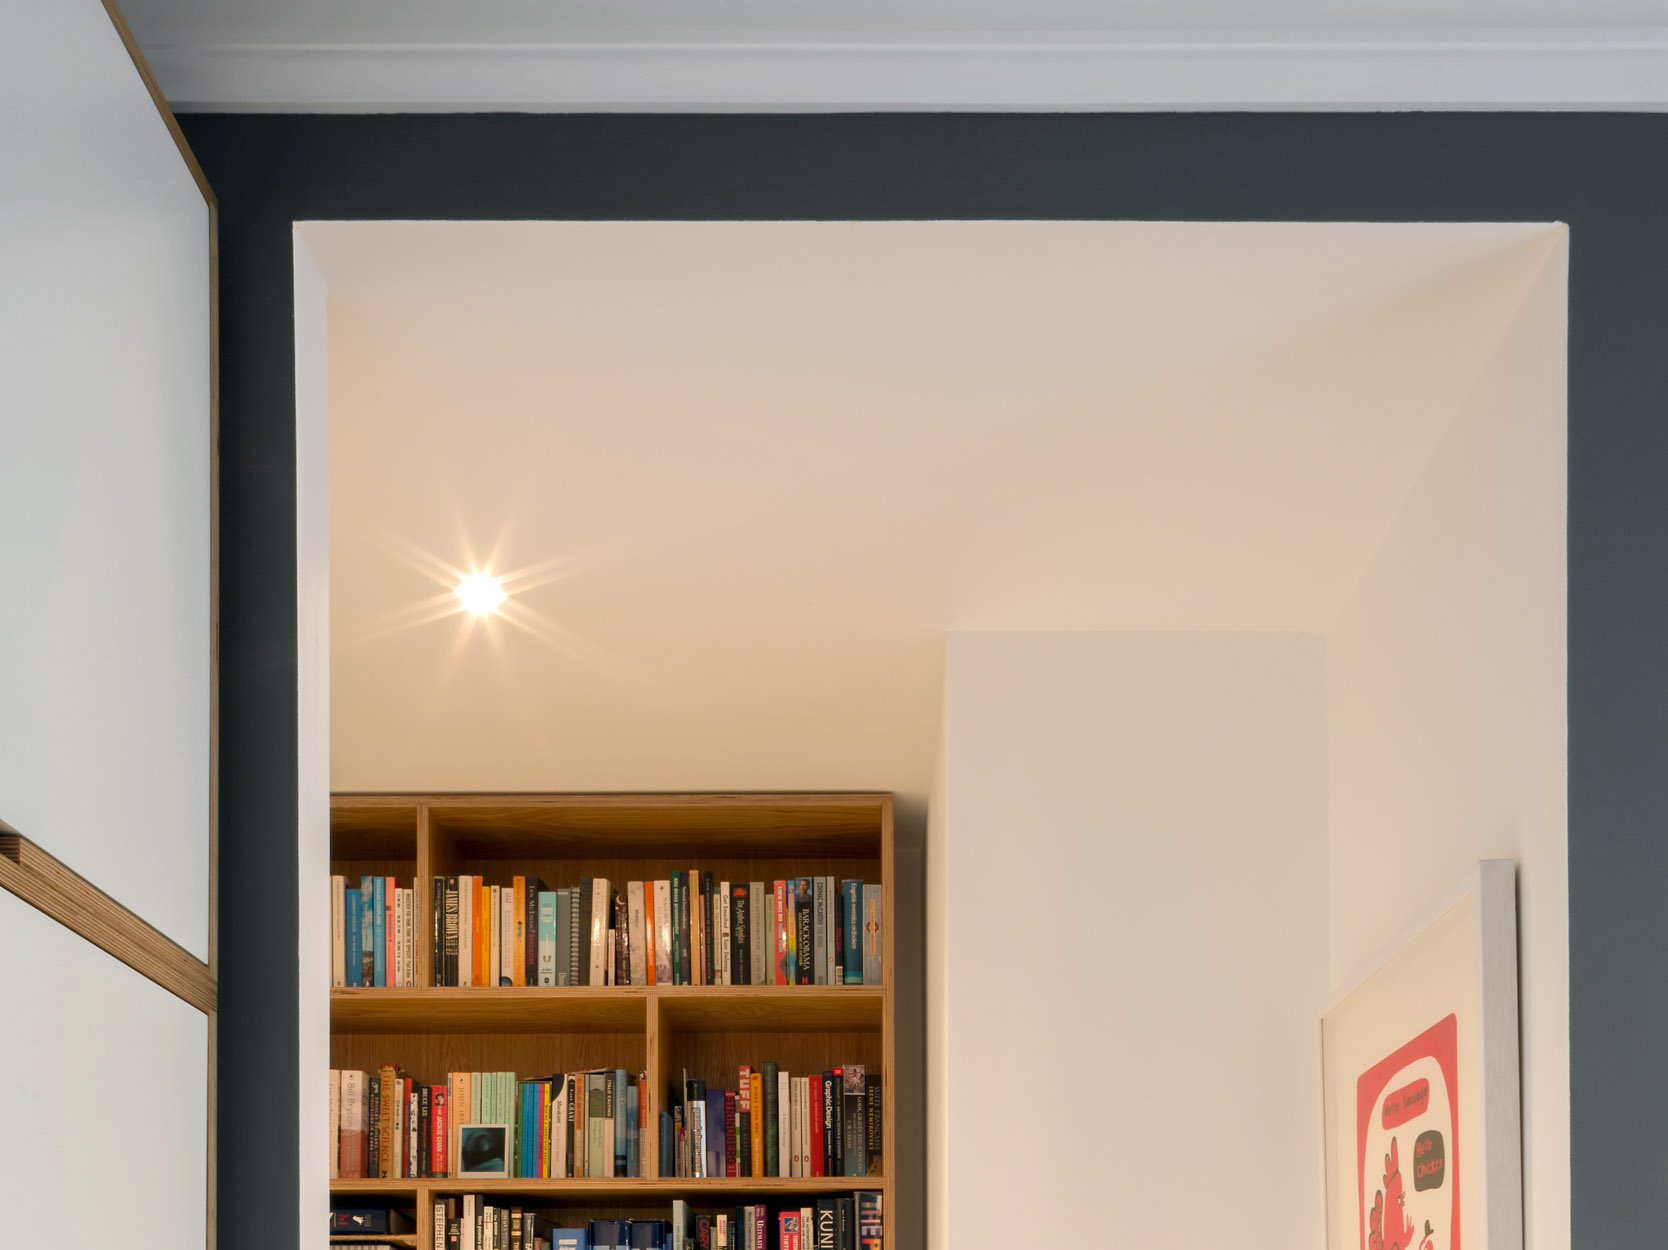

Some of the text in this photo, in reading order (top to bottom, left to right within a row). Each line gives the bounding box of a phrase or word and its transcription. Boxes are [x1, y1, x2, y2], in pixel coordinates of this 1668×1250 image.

[446, 889, 458, 939] JAMES BROWN
[345, 1083, 355, 1127] Bill Bryson
[740, 1068, 750, 1110] TUFF
[824, 1081, 833, 1128] Graphic Design
[1384, 1086, 1427, 1118] Hello Sausage
[382, 1075, 391, 1162] THE SWEET SCIENCE
[725, 1097, 736, 1165] STRINDBERG
[1416, 1141, 1432, 1156] Hello
[1417, 1159, 1443, 1177] Chicken
[436, 1207, 444, 1248] STEPHEN
[699, 1220, 709, 1249] CARY
[861, 1195, 883, 1236] THE
